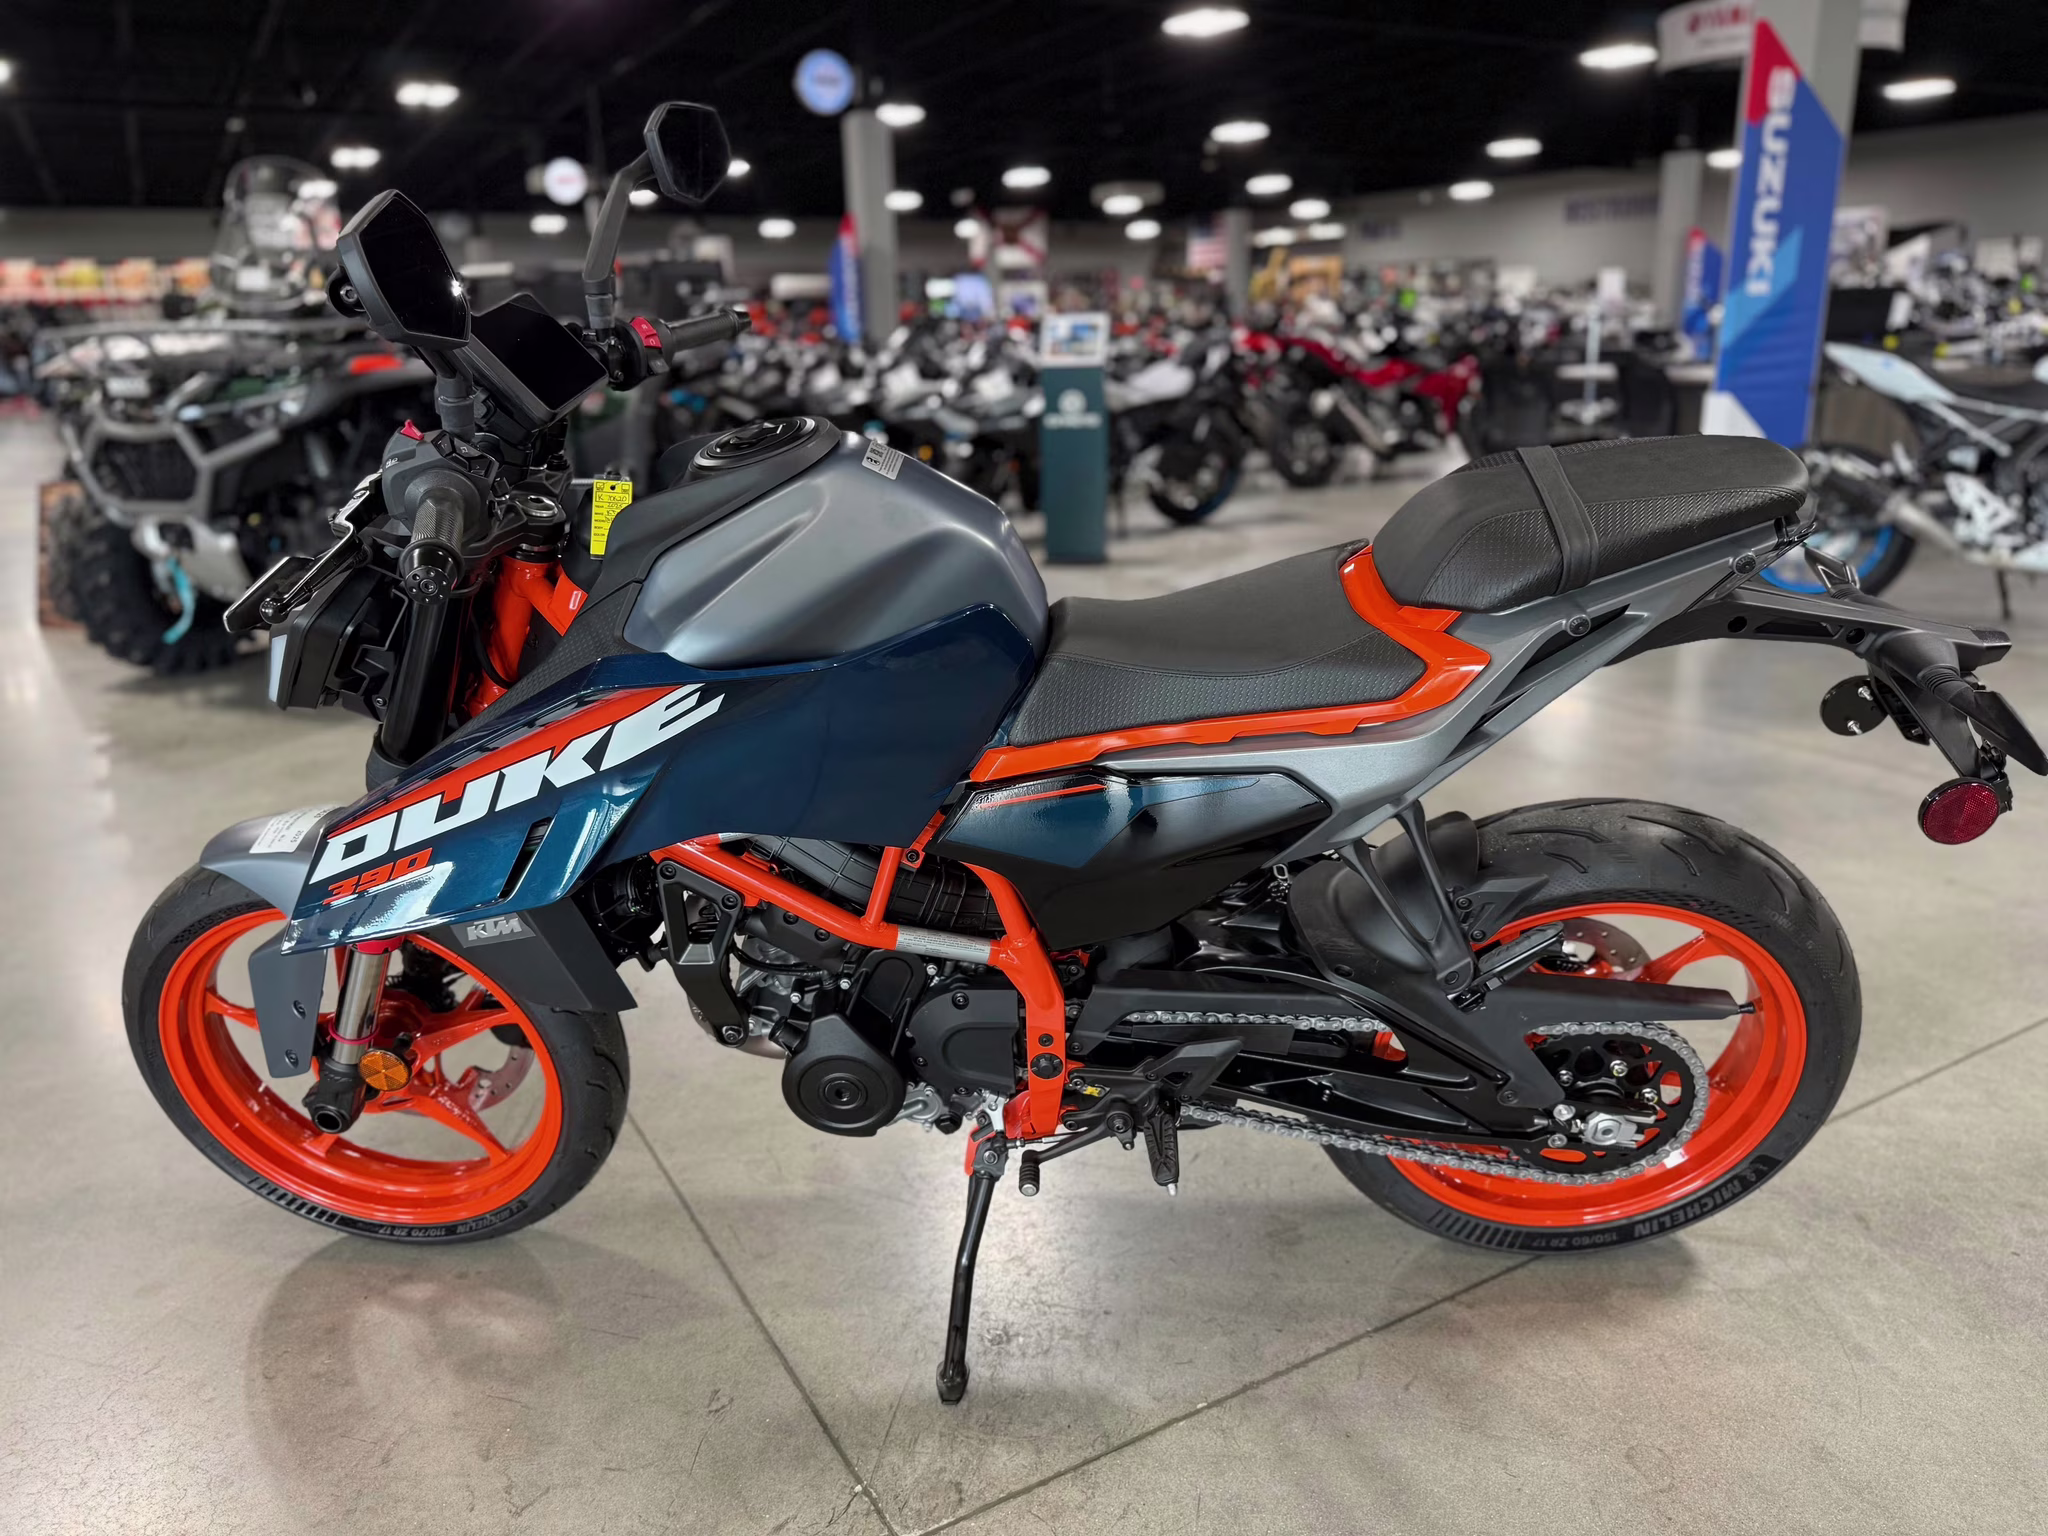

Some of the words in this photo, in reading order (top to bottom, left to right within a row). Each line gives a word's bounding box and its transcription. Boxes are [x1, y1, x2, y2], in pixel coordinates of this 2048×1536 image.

[1745, 66, 1797, 296] SUZUKI
[308, 683, 727, 885] DUKE
[322, 847, 433, 904] 390
[467, 916, 524, 941] KTM
[1633, 1180, 1743, 1239] MICHELIN
